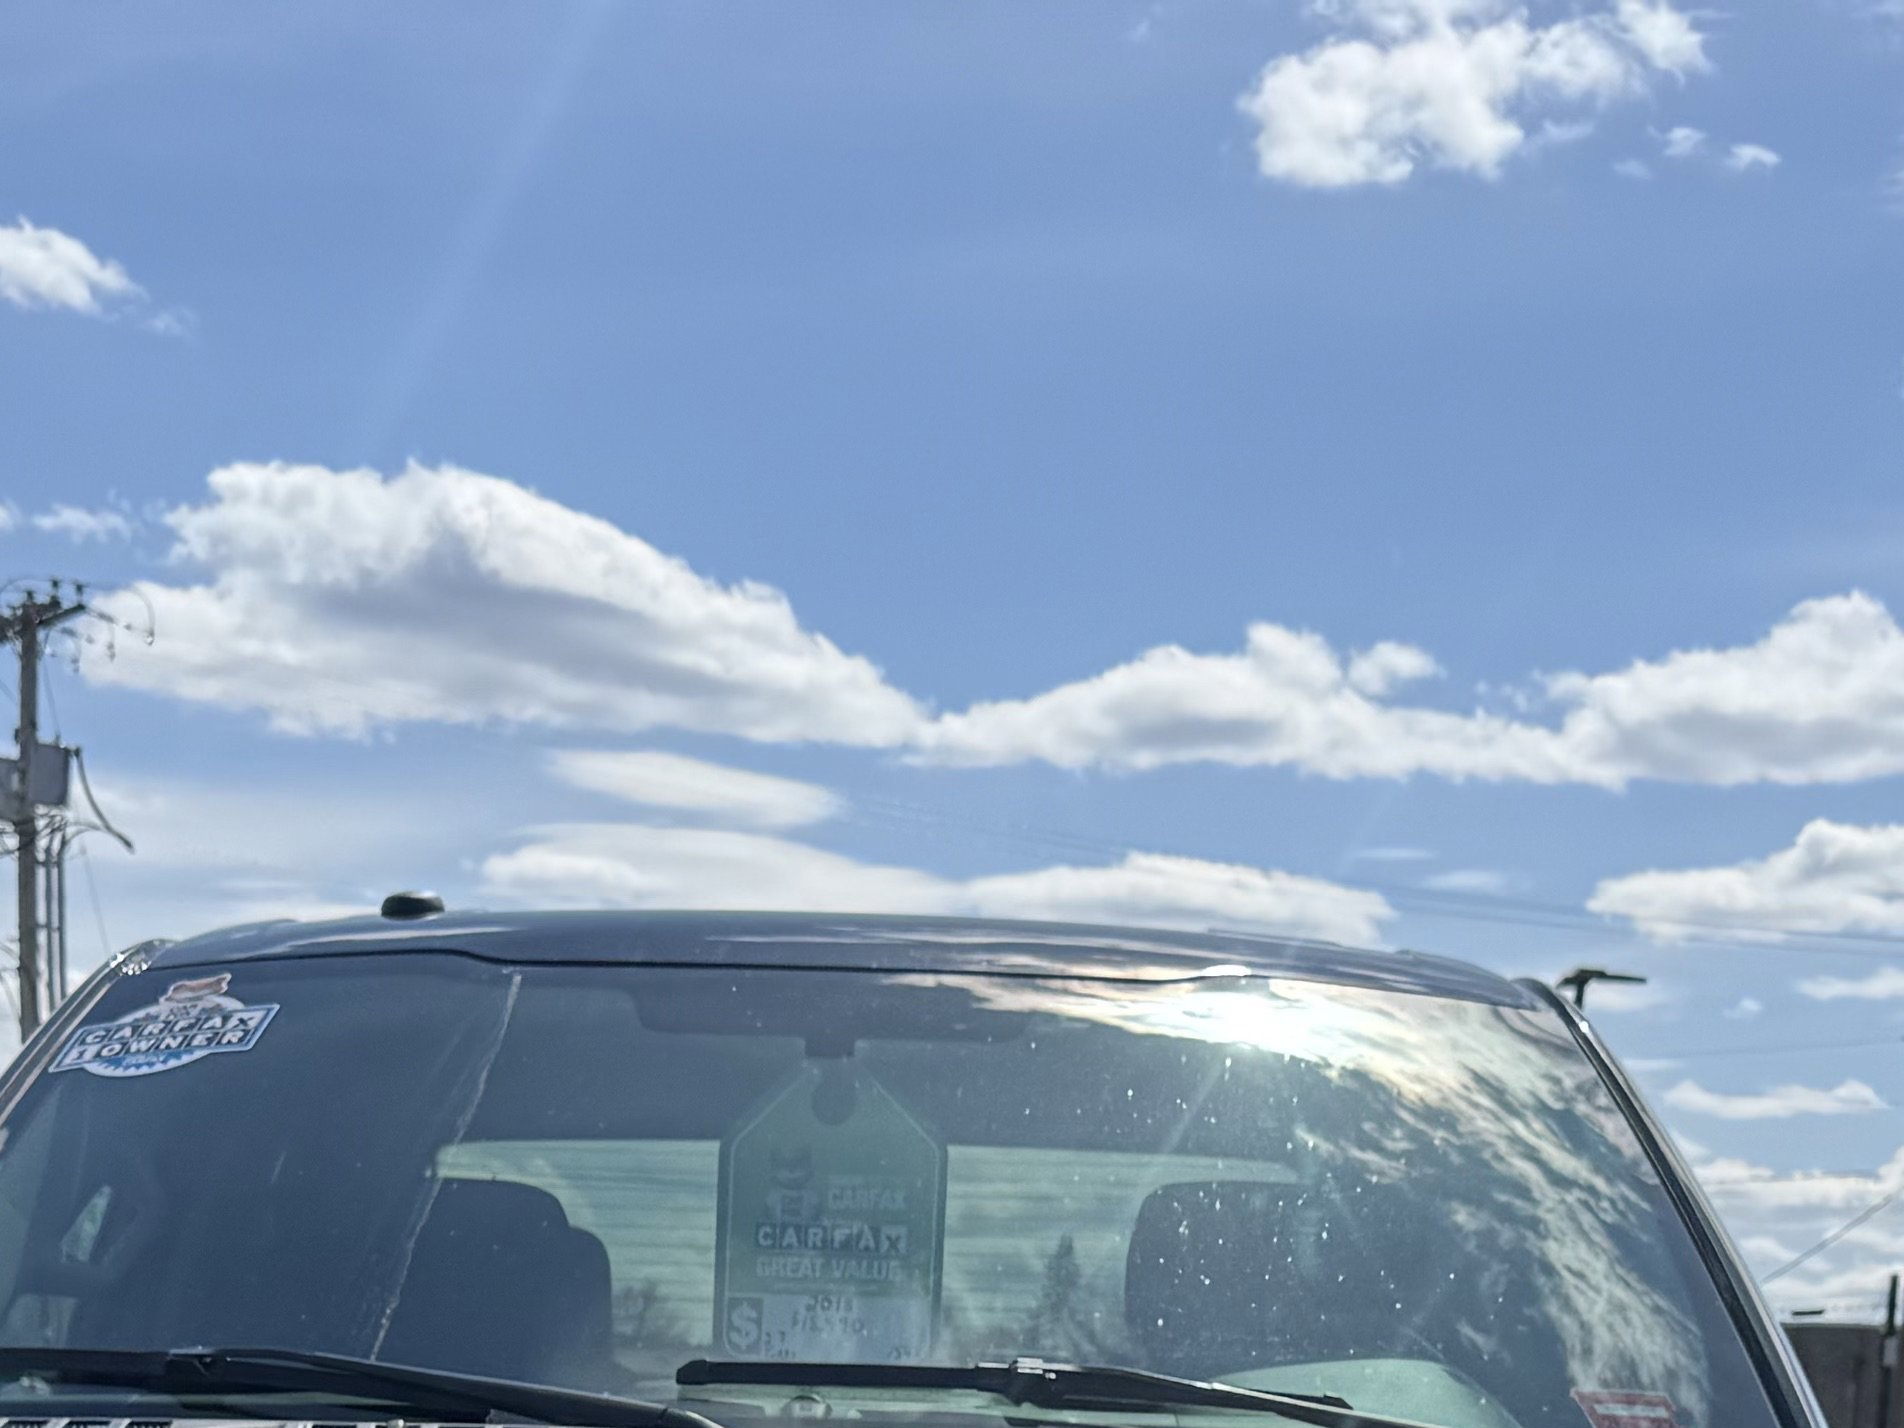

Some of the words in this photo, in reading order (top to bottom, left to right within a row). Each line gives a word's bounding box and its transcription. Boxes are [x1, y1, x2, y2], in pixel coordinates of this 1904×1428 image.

[82, 1011, 259, 1046] CARFAX
[99, 1030, 246, 1058] OWNER
[757, 1225, 906, 1255] CARFAX
[755, 1256, 824, 1278] GREAT
[830, 1258, 902, 1281] VALUE
